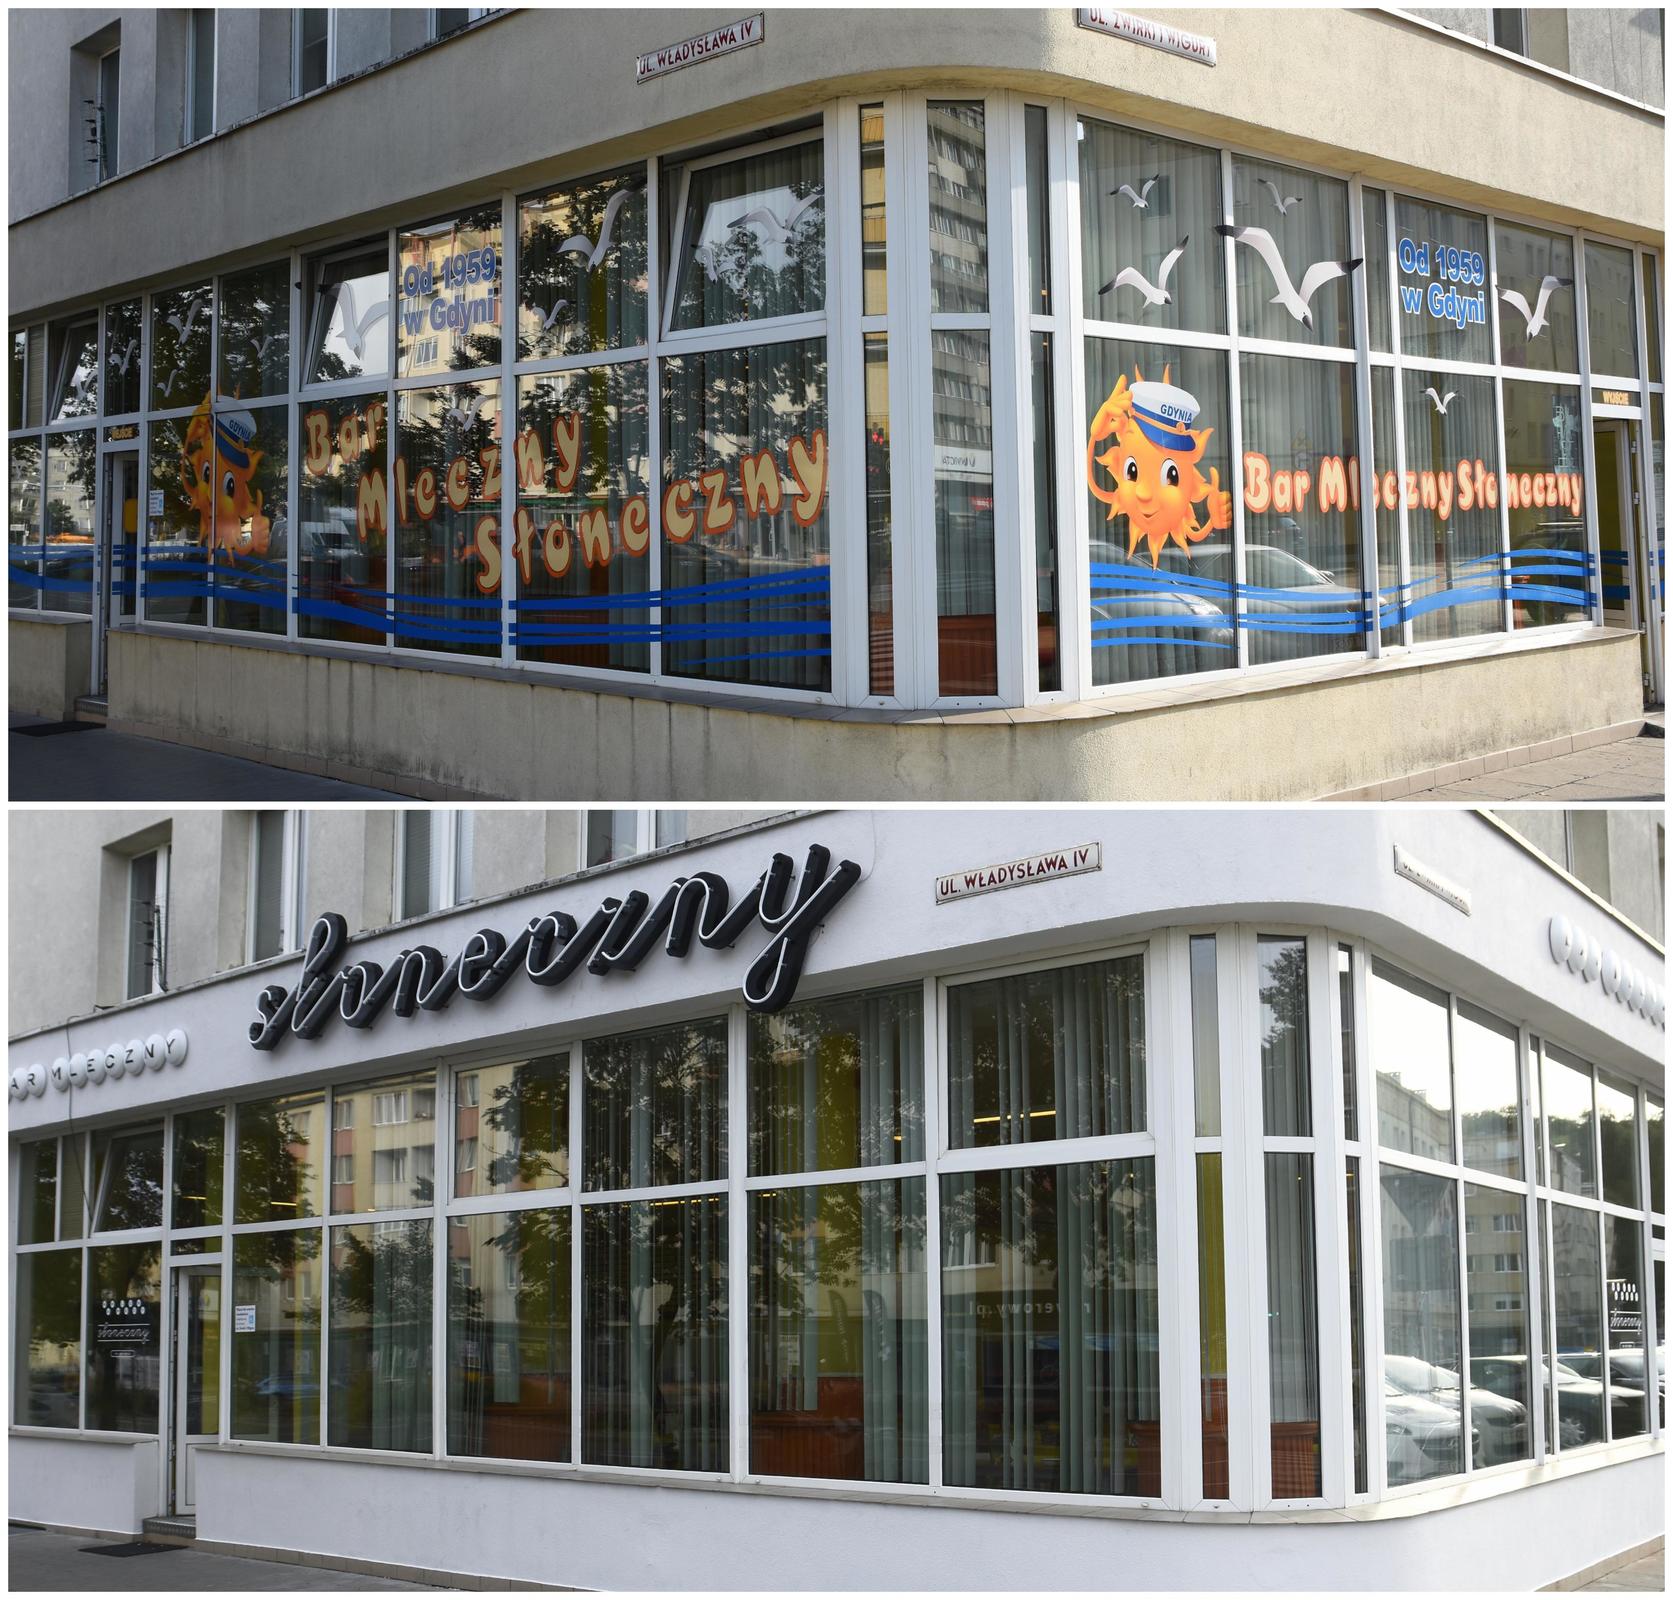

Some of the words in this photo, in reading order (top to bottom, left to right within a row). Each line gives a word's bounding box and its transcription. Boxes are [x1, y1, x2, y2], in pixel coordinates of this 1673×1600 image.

[639, 57, 655, 75] UL.
[656, 27, 737, 68] WŁADYSŁAWA
[740, 20, 754, 41] IV
[403, 261, 434, 298] Od
[441, 245, 497, 290] 1959
[1398, 237, 1430, 277] Od
[1435, 244, 1485, 287] 1959
[404, 309, 425, 336] w
[429, 288, 495, 337] Gdyni
[1400, 285, 1423, 315] w
[1427, 282, 1486, 330] Gdyni
[1160, 403, 1193, 423] GDYNIA
[304, 402, 384, 476] Bar
[357, 410, 582, 543] Mleczny
[1243, 450, 1311, 513] Bar
[1456, 458, 1583, 518] Słoneczny
[473, 427, 828, 595] Słoneczny
[940, 878, 961, 896] UL.
[964, 854, 1068, 890] WŁADYSŁAWA
[1073, 848, 1090, 867] IV
[52, 1038, 175, 1081] MLECZNY
